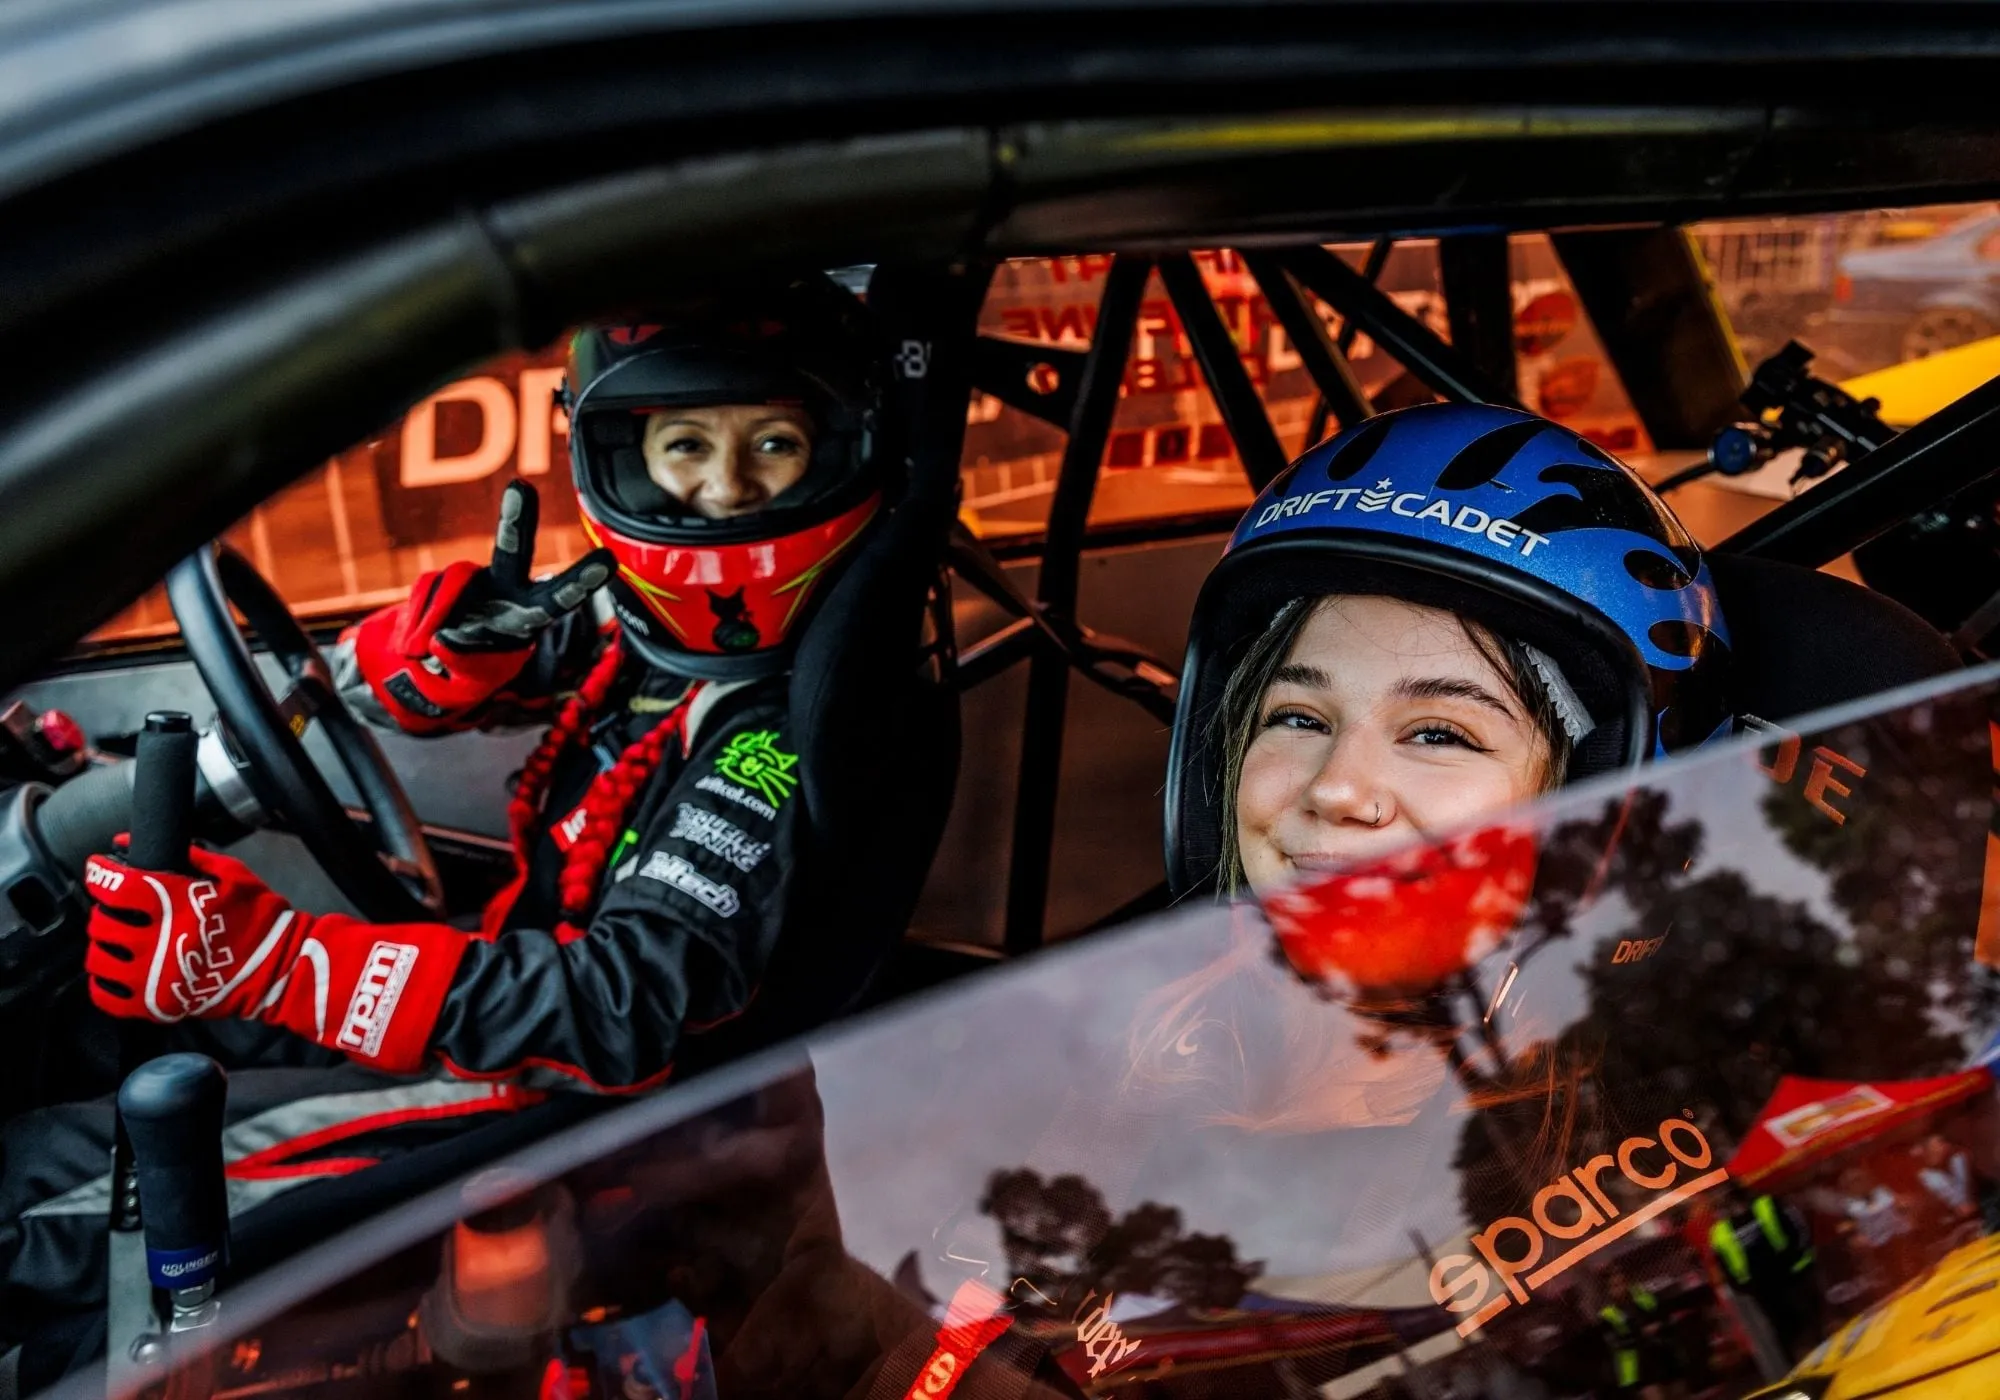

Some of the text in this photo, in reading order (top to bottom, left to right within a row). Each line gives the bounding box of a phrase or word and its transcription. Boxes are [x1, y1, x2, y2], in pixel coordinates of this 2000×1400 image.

[1254, 487, 1550, 557] DRIFT CADET
[341, 946, 400, 1047] rpm
[1429, 1118, 1713, 1313] sparco
